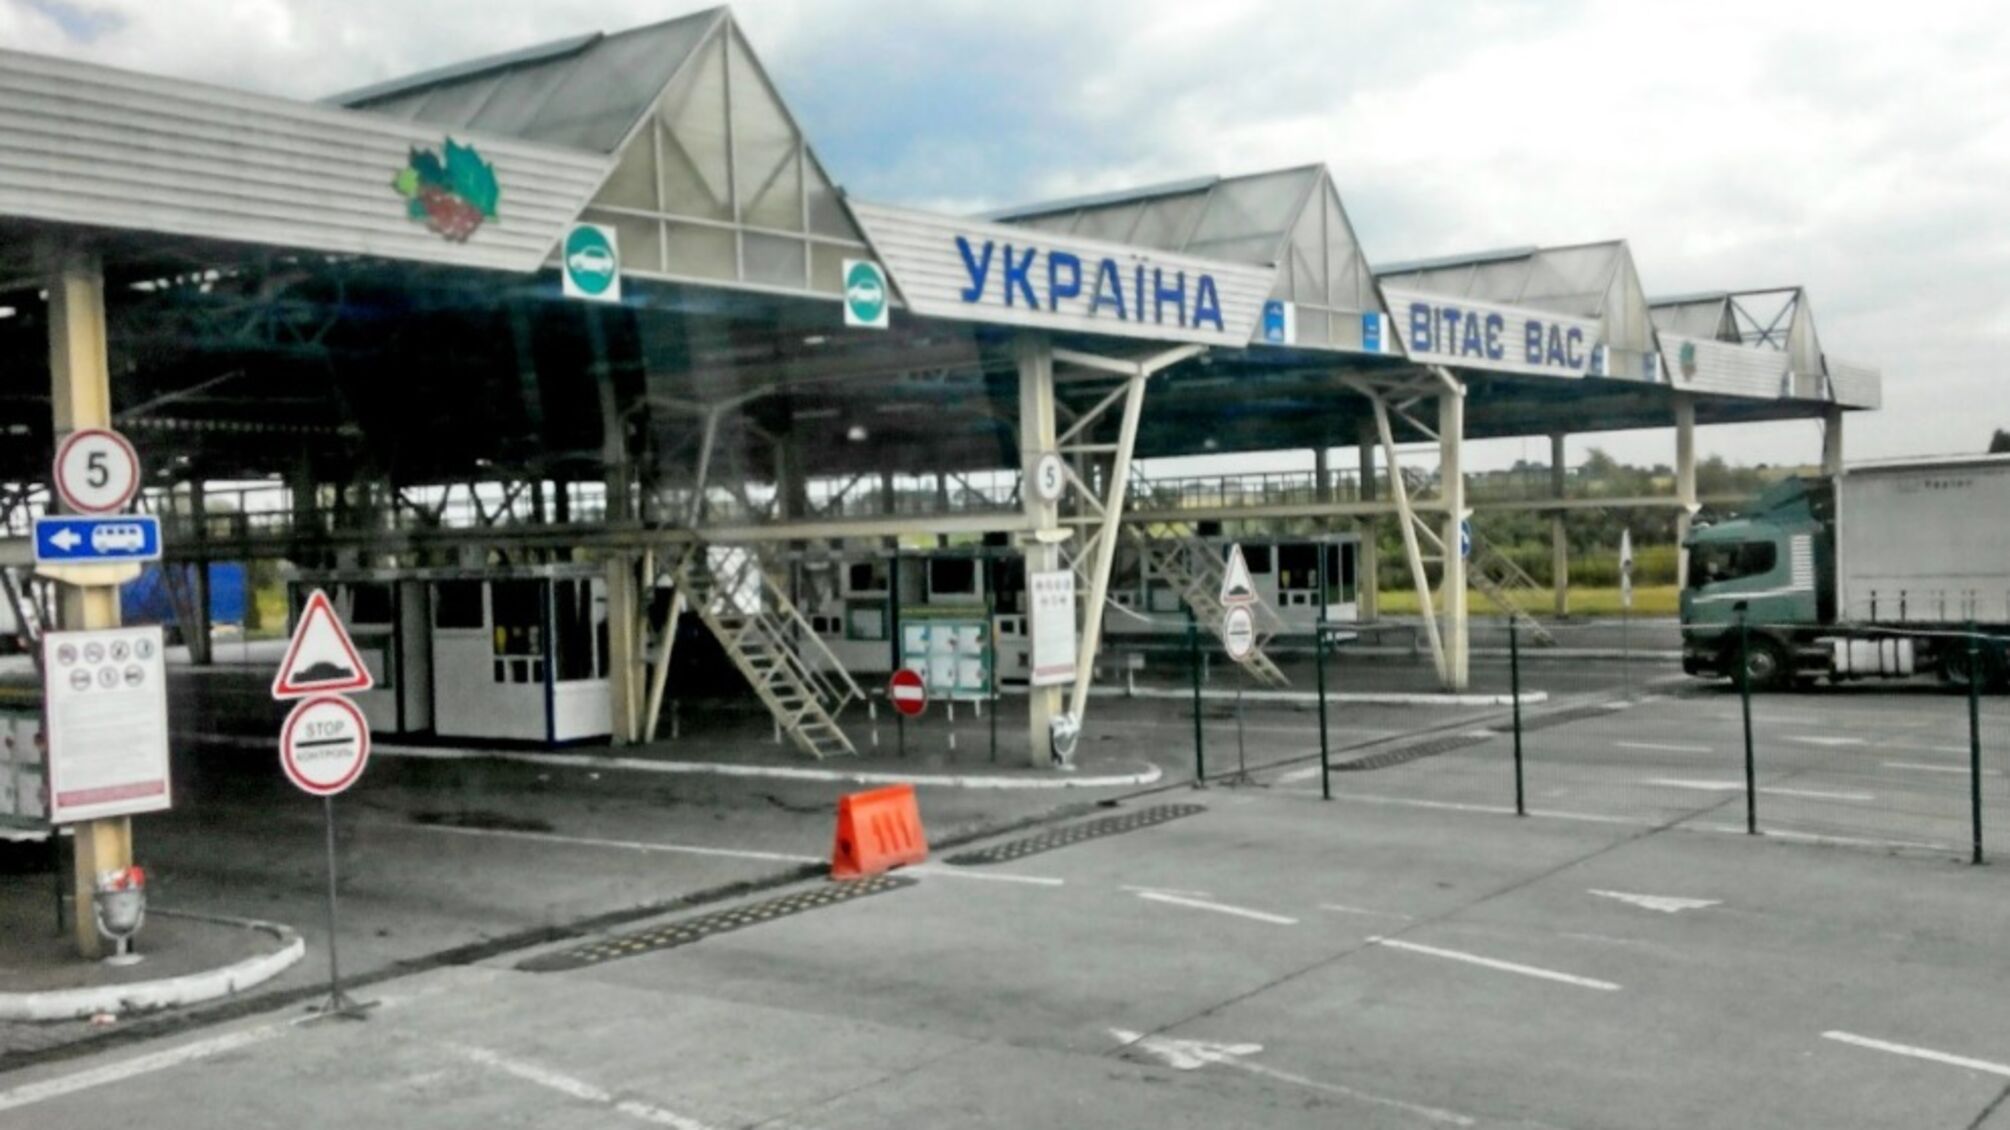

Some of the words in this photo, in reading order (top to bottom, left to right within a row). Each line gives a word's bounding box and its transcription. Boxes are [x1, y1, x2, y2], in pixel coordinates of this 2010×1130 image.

[955, 235, 1224, 332] УКРАЇНА
[1410, 302, 1504, 360] ВІТАЄ
[1525, 320, 1583, 369] ВАС
[87, 451, 109, 489] 5
[1045, 466, 1056, 489] 5
[305, 720, 345, 738] STOP
